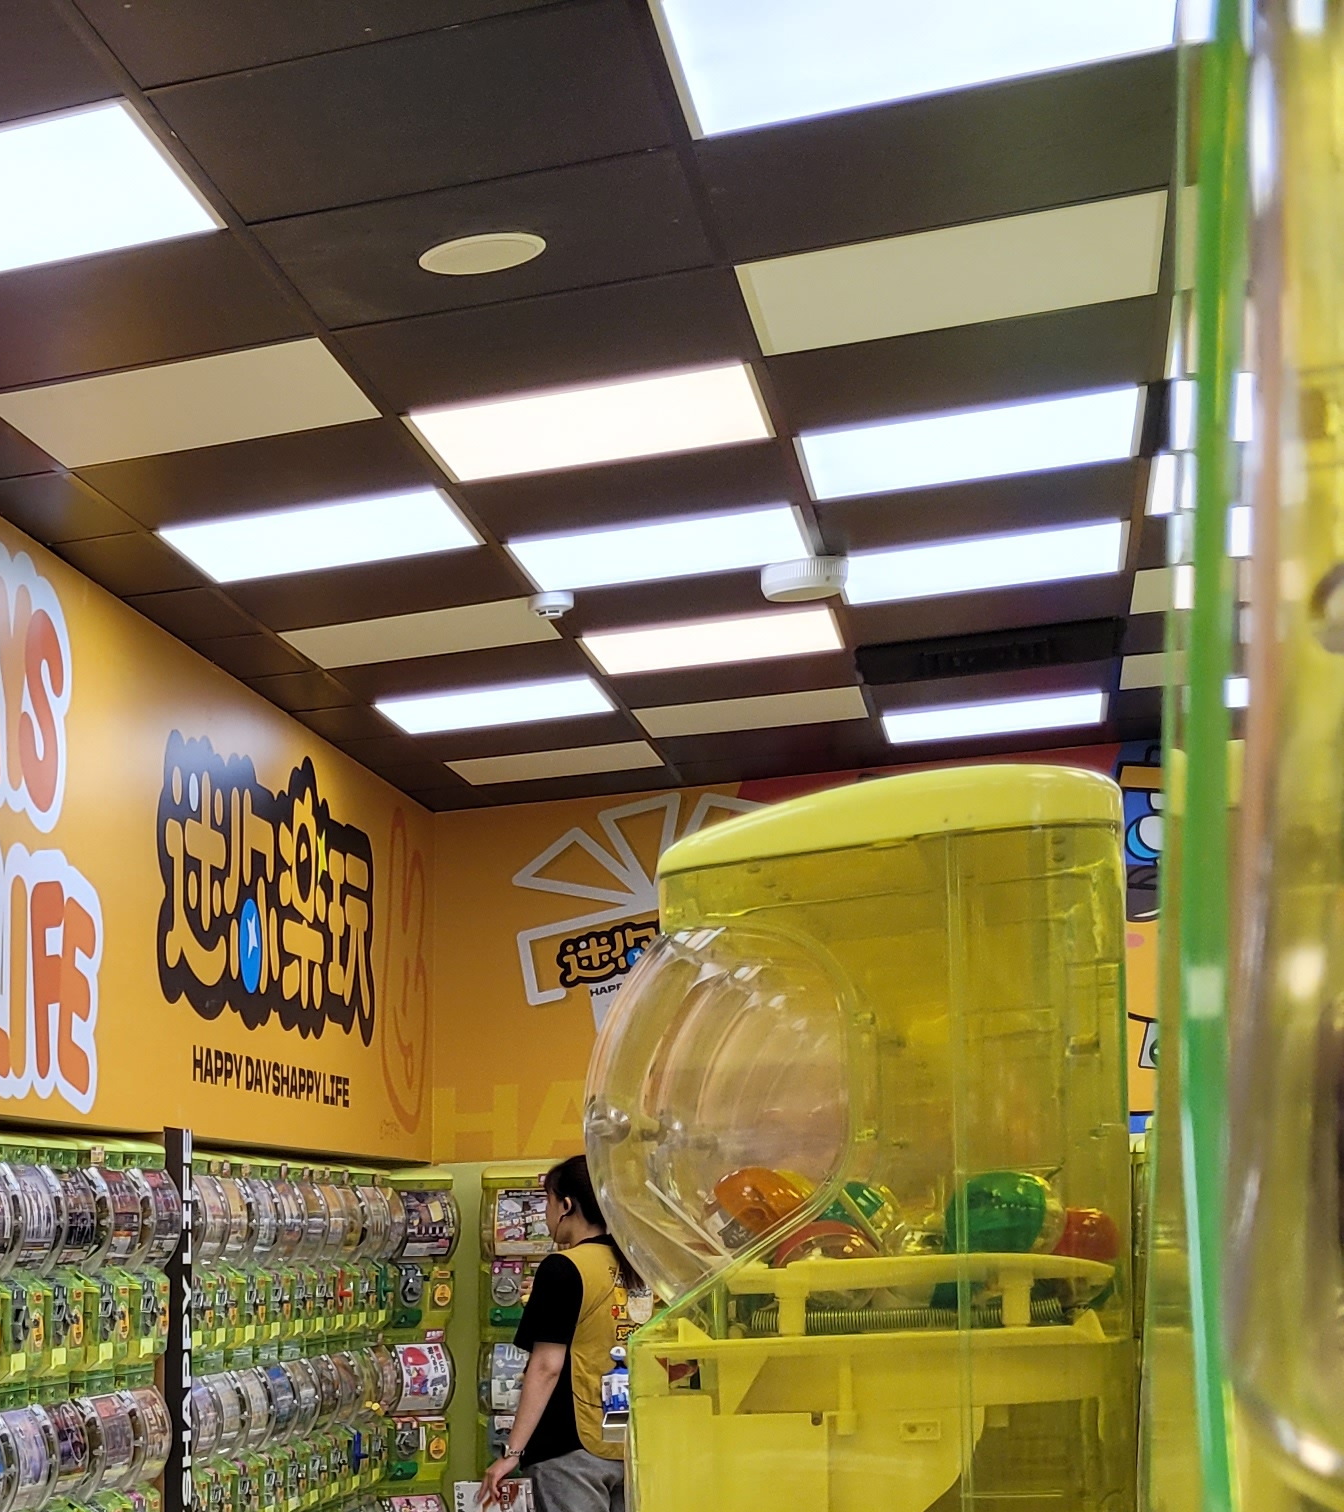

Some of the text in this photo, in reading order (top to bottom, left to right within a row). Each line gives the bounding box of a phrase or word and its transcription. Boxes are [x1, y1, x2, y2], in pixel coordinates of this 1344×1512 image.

[193, 1045, 241, 1088] HAPPY
[322, 1073, 350, 1109] LIFE
[182, 1129, 192, 1265] LIFE
